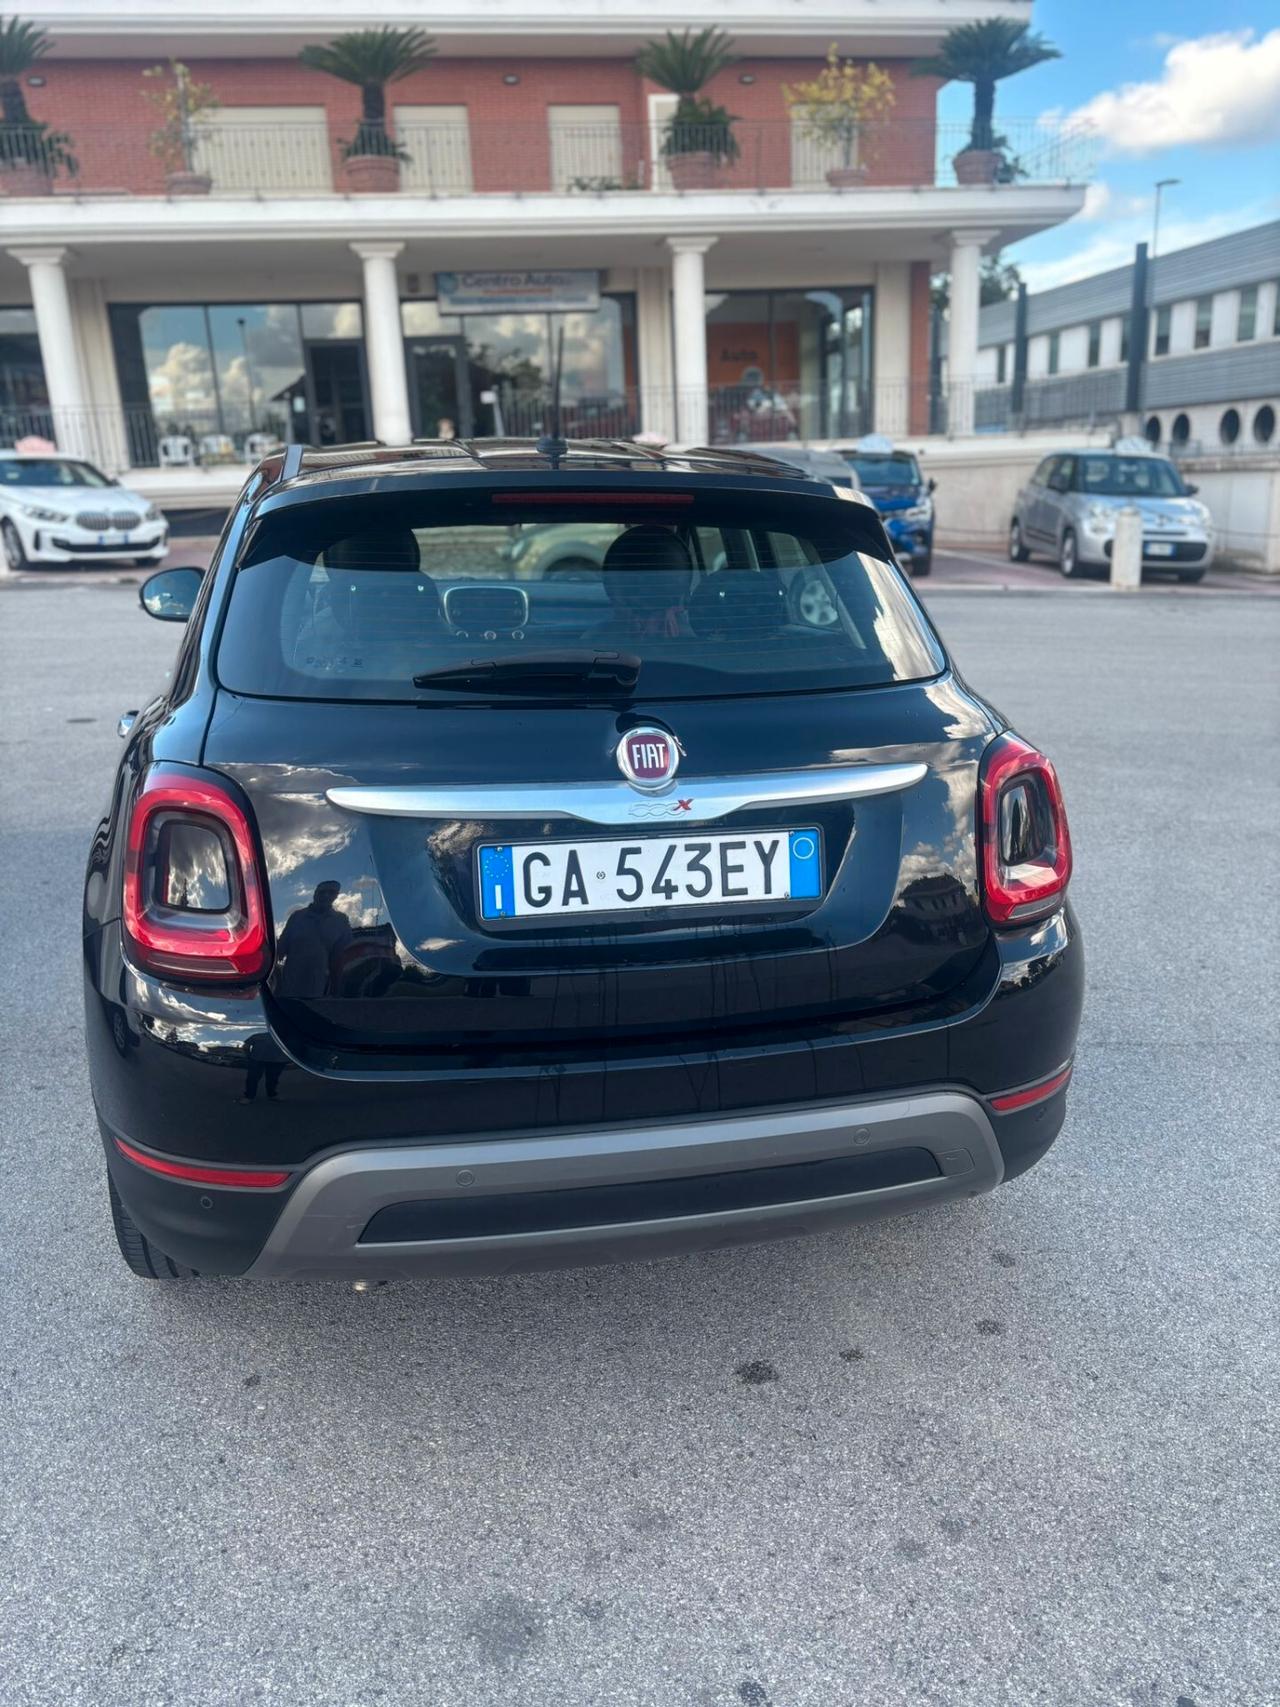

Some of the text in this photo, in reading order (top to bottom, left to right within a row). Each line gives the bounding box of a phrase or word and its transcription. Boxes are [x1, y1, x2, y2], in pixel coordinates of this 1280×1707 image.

[462, 272, 522, 287] Centro
[632, 743, 666, 769] FIAT
[522, 839, 780, 908] GA 543EY
